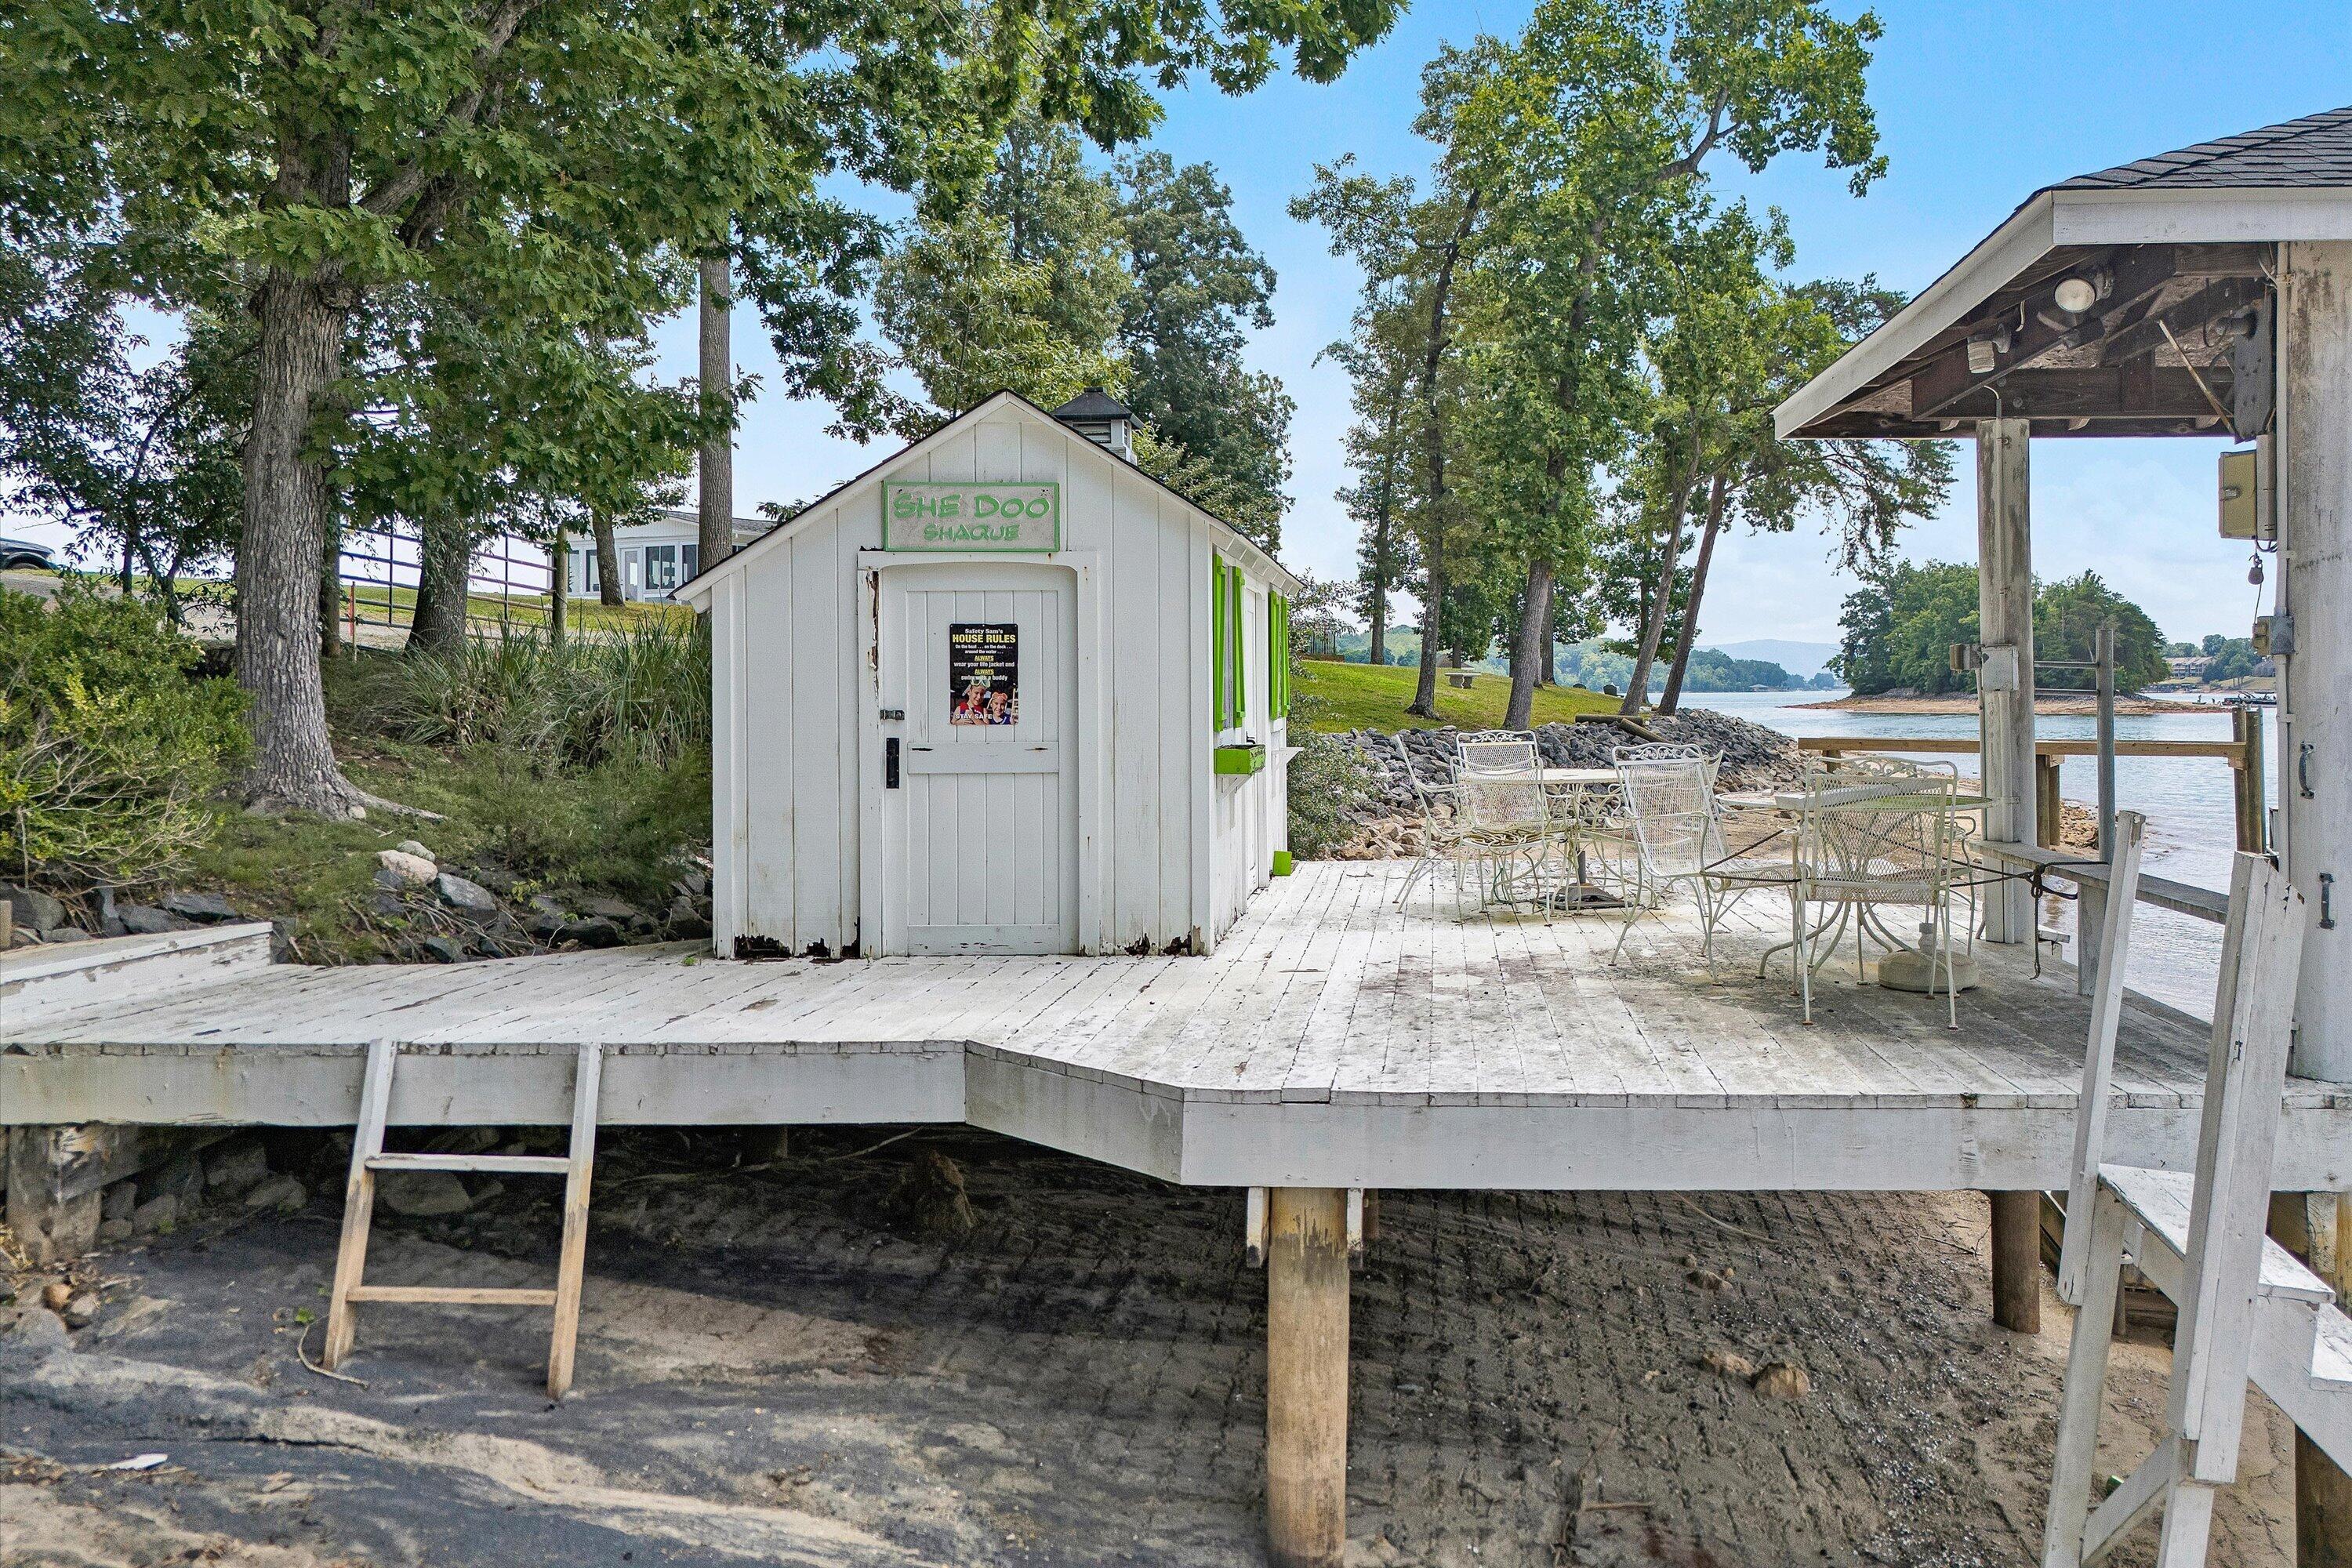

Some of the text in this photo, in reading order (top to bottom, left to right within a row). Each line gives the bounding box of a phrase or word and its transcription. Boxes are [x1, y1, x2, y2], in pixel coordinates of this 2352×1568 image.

[894, 493, 1051, 518] SHE DOO
[924, 523, 1021, 542] SHAQUE
[952, 634, 1016, 643] HOUSE RULES
